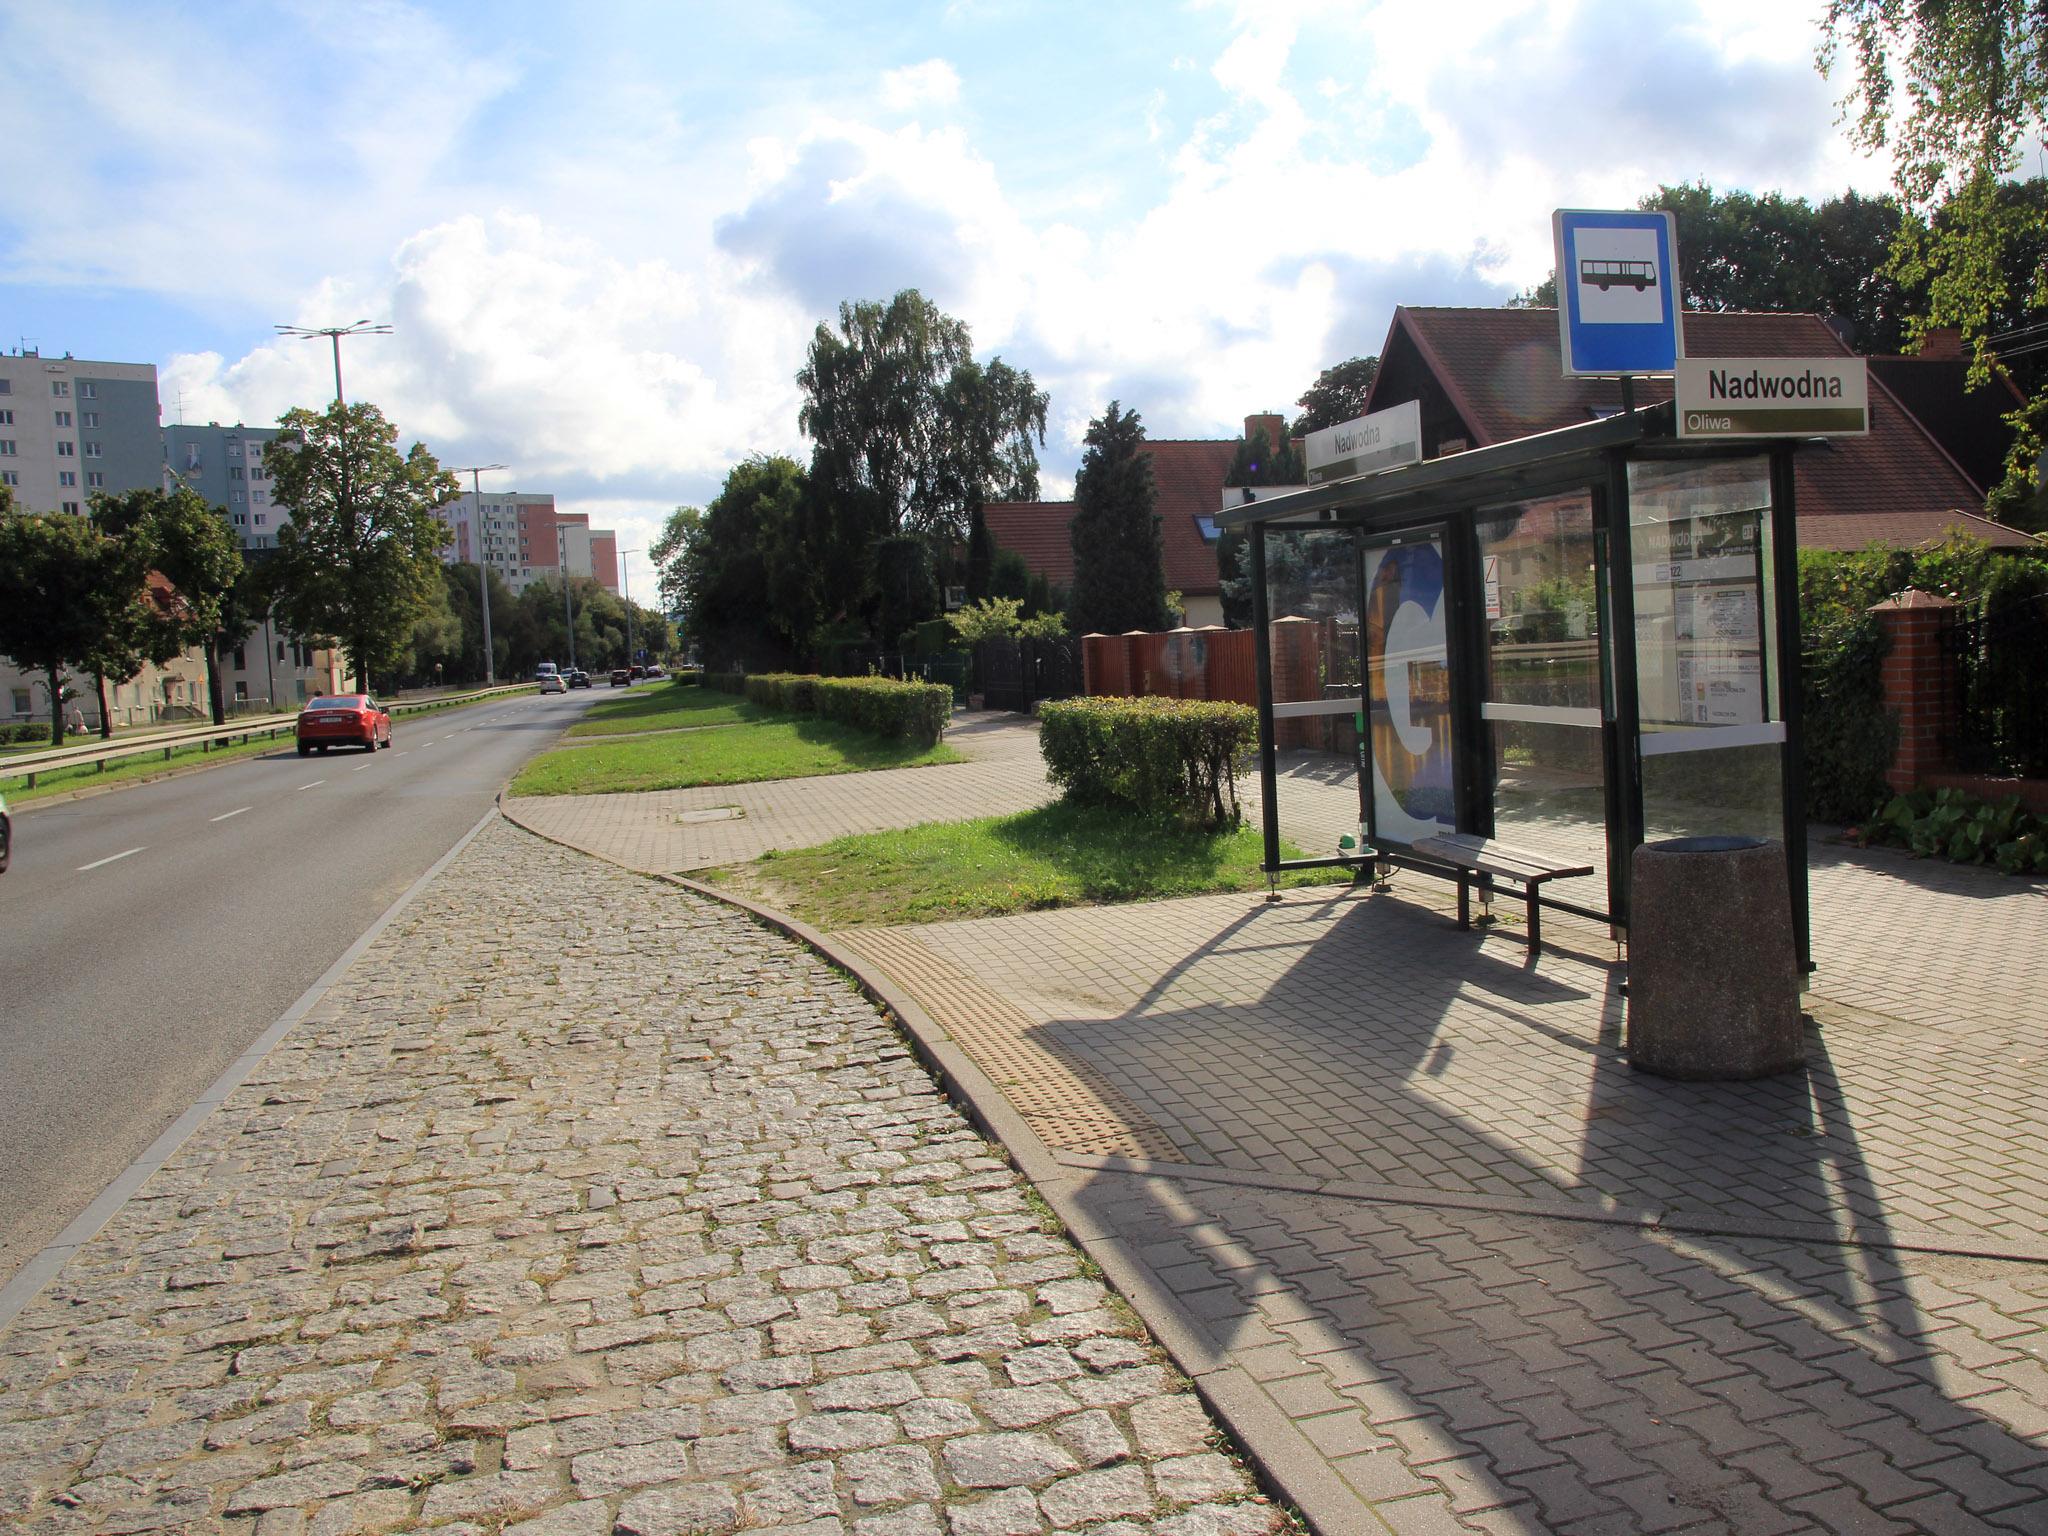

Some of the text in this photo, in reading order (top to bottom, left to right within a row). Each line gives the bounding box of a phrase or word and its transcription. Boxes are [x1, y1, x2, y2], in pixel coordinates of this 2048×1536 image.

[1709, 370, 1842, 398] Nadwodna
[1688, 414, 1731, 430] Oliwa
[1335, 425, 1380, 455] Nadwodna
